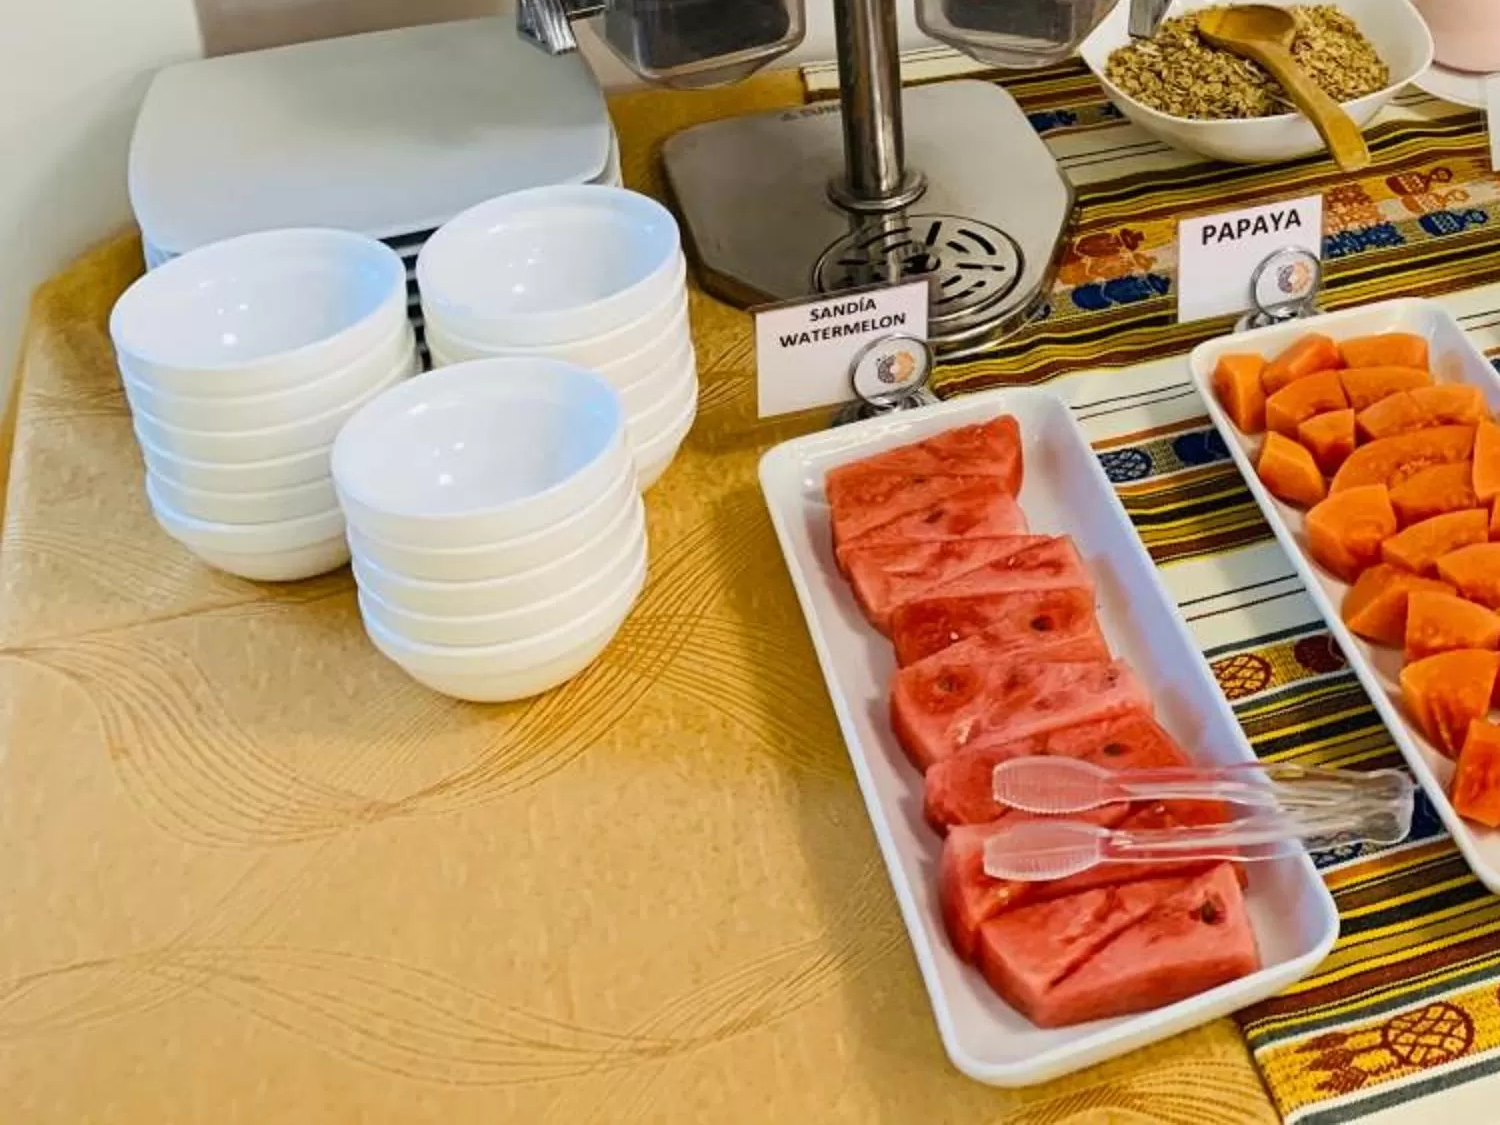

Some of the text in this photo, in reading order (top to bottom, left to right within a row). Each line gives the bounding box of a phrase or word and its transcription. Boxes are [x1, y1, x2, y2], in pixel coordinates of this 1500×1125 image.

[1201, 208, 1302, 246] PAPAYA
[809, 296, 878, 322] SANDÍA
[778, 312, 907, 348] WATERMELON
